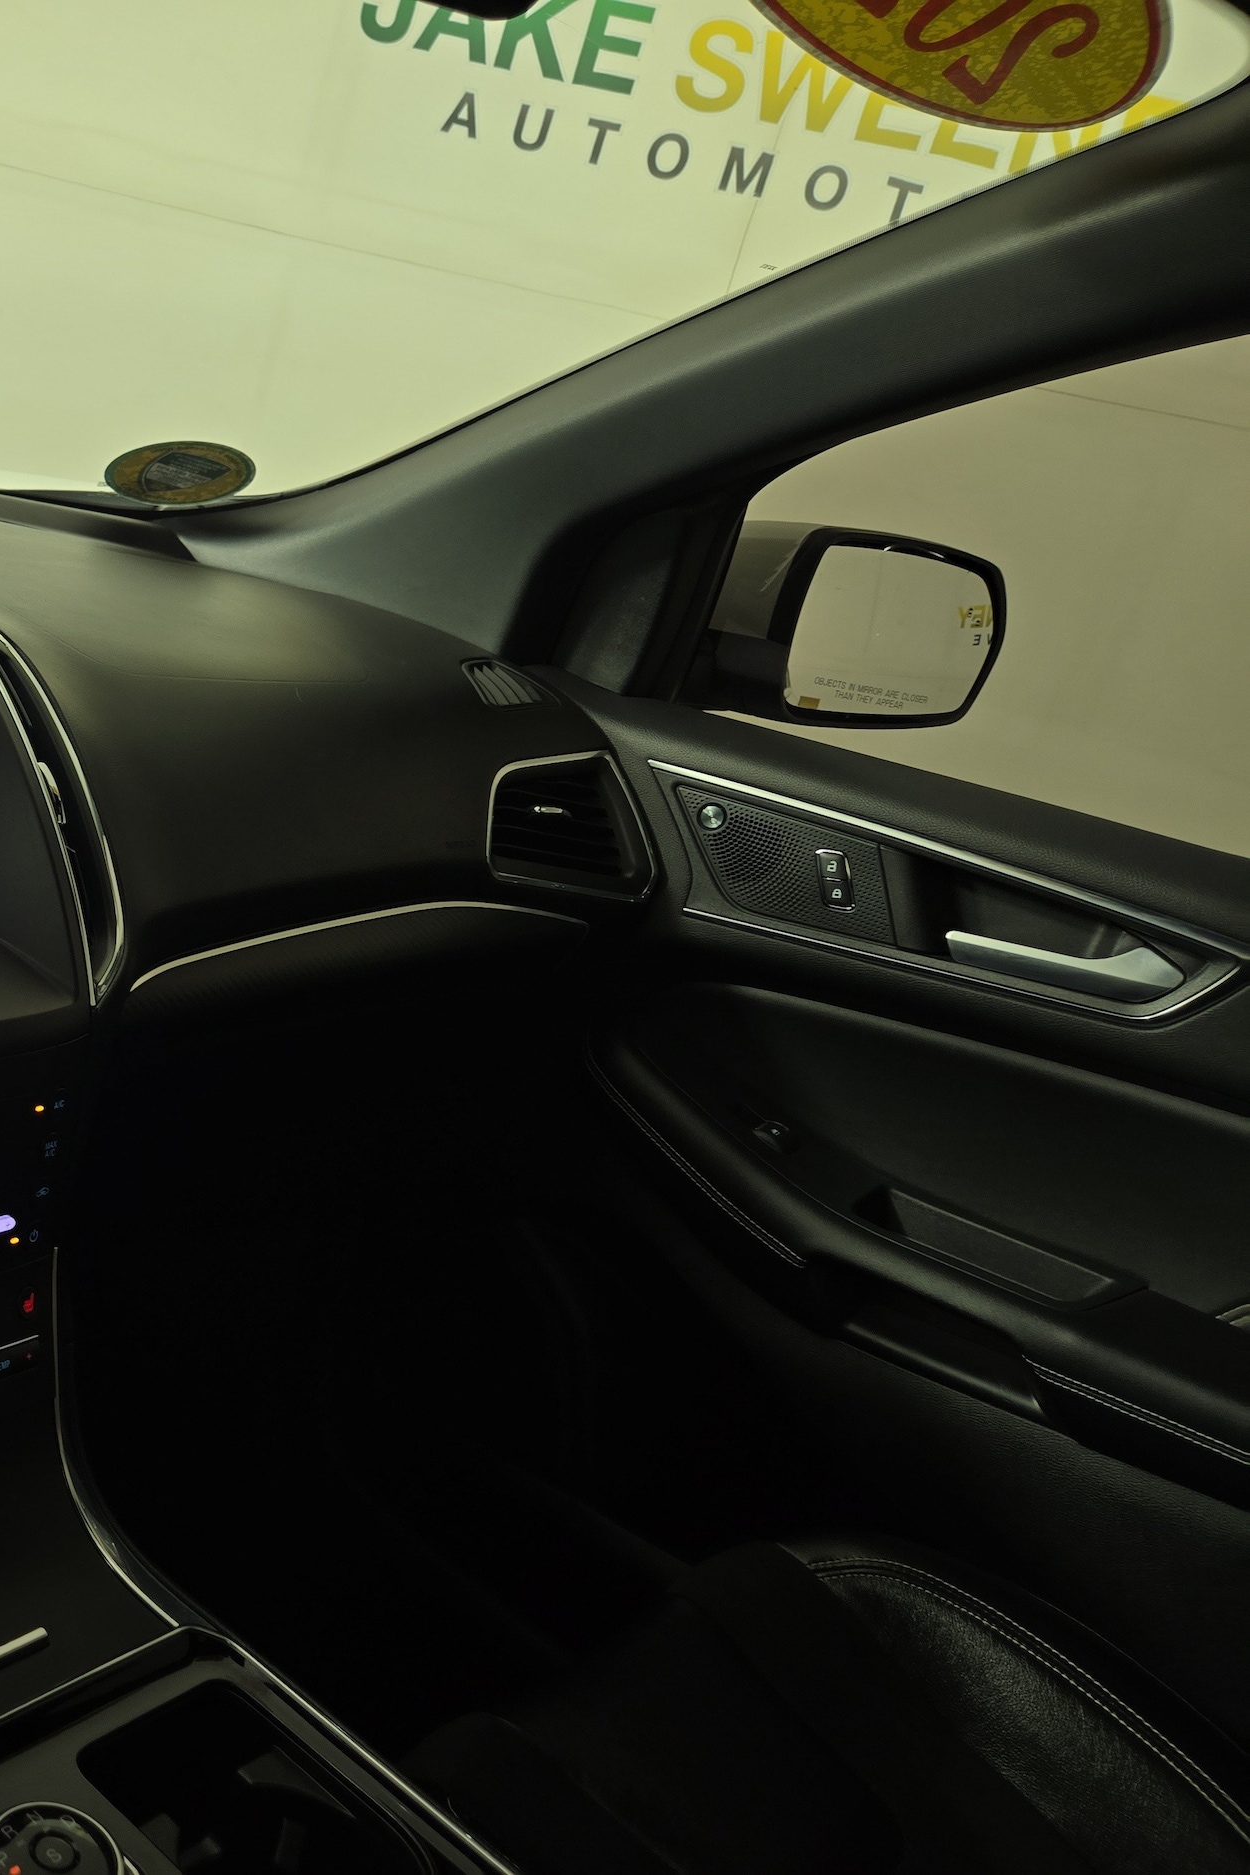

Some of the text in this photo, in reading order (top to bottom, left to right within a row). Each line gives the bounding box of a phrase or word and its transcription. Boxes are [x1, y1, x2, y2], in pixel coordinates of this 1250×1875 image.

[361, 0, 656, 95] JAKE
[814, 676, 929, 704] OBJECTS IN MIRROR ARE CLOSER
[835, 689, 904, 710] THAN THEY APPEAR
